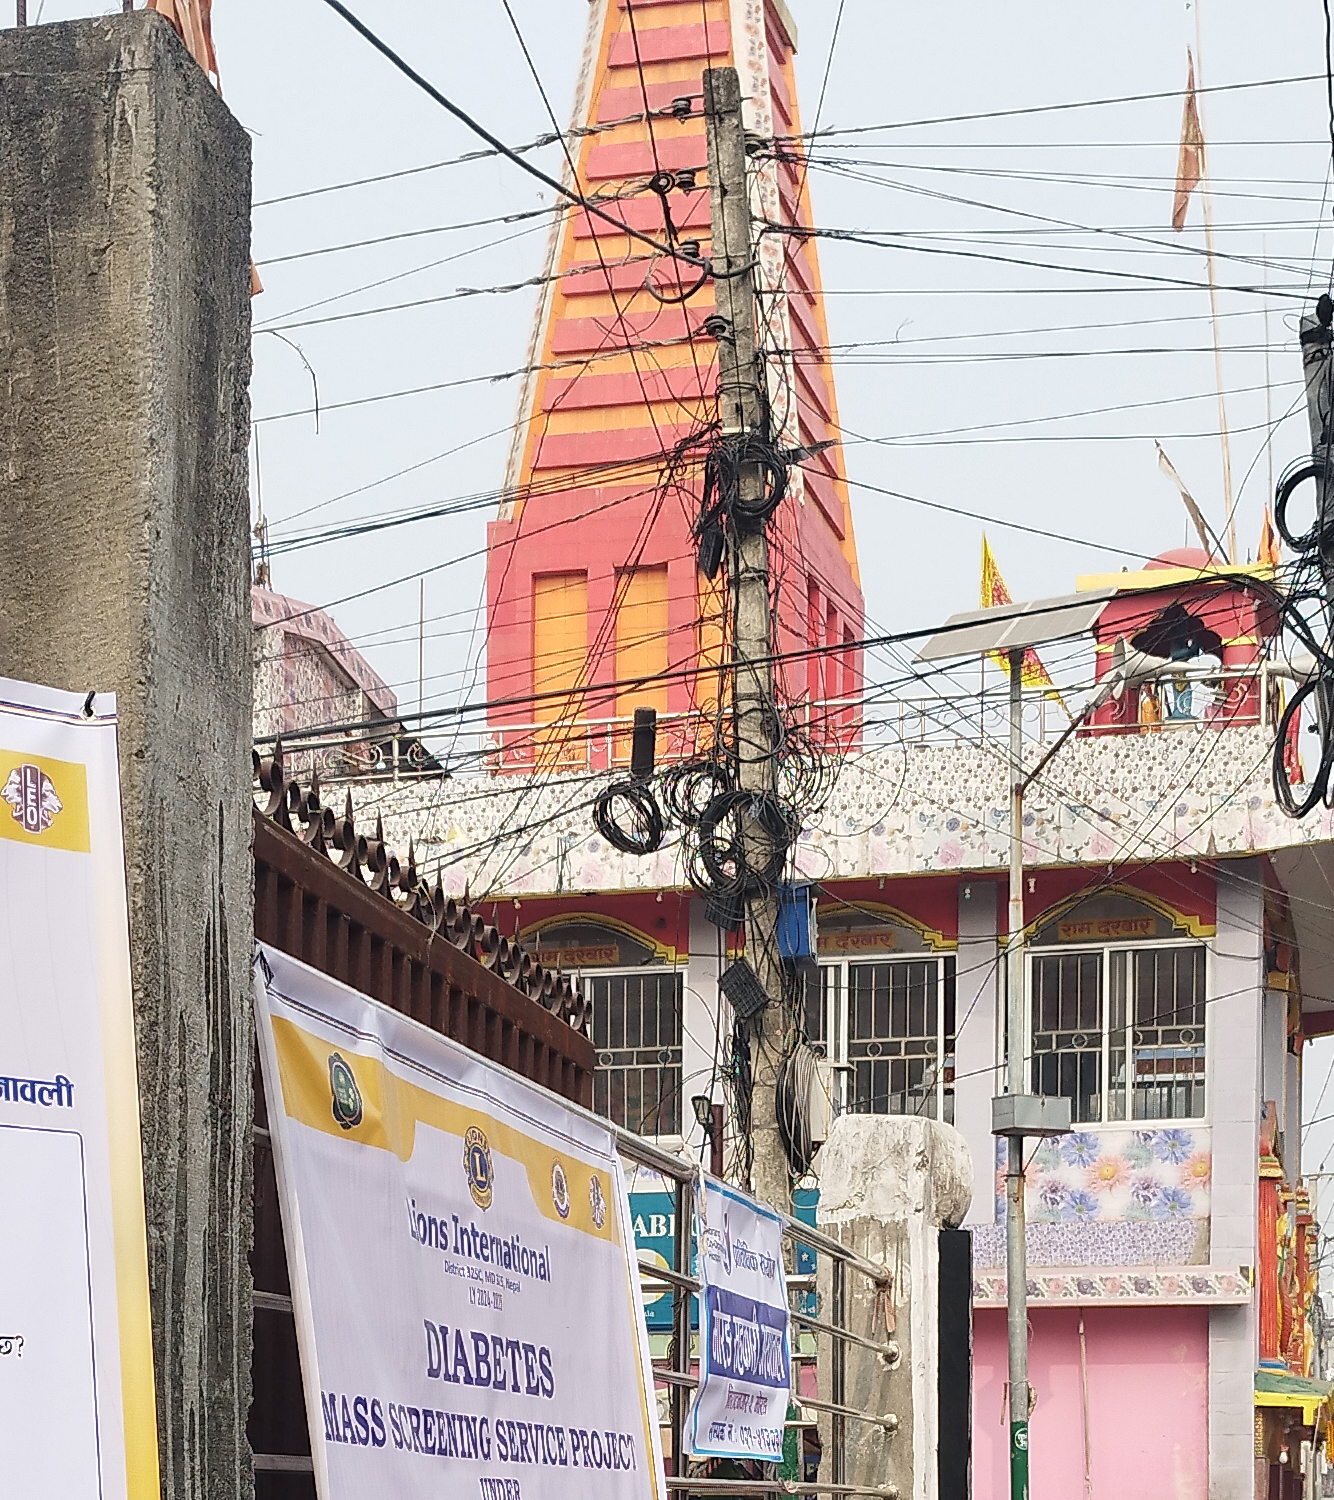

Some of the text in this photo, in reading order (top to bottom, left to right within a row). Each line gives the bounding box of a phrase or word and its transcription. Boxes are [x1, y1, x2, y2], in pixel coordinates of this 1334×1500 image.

[25, 767, 39, 826] LEO
[475, 1152, 487, 1182] L
[406, 1197, 551, 1283] Lions International
[424, 1318, 555, 1399] DIABETES
[323, 1391, 637, 1472] MASS SCREENING SERVICE PROJECT
